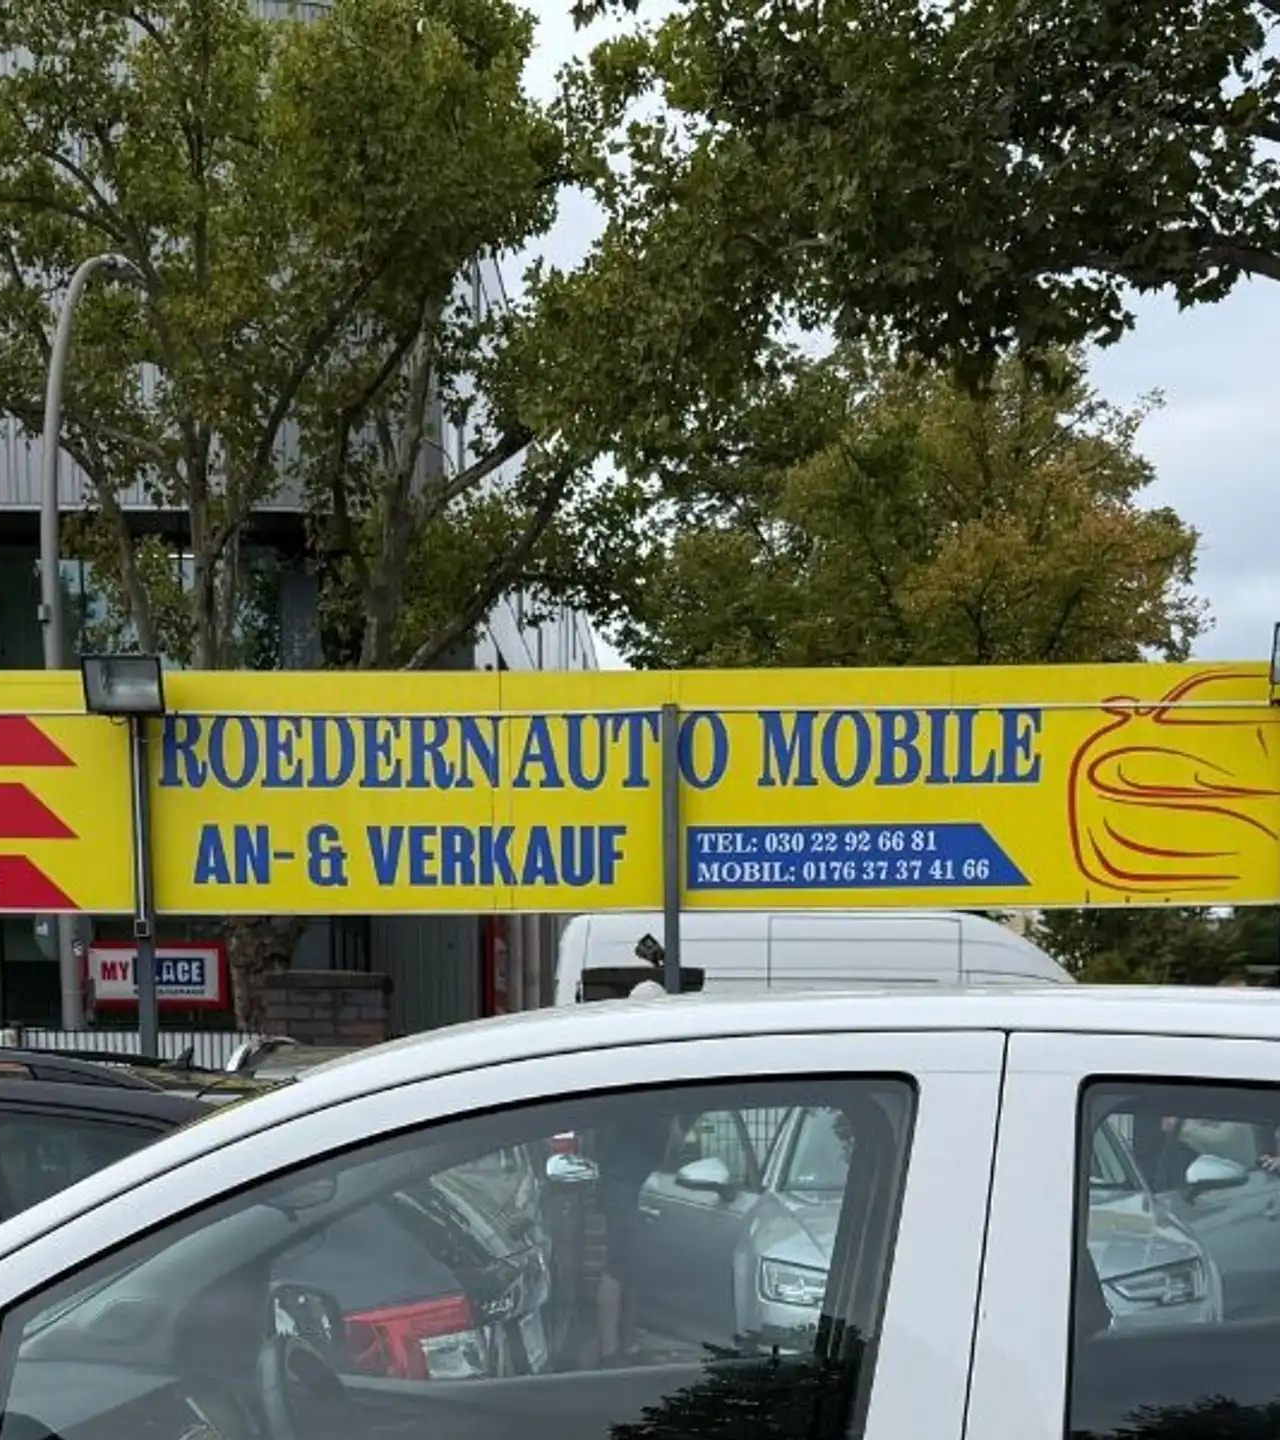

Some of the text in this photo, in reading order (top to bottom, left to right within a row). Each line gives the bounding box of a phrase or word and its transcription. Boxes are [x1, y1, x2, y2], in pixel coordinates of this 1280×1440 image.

[757, 708, 1042, 788] MOBILE
[697, 830, 937, 853] TEL: 030 22 92 66 81
[193, 824, 627, 886] AN- & VERKAUF
[697, 858, 990, 883] MOBIL: 0176 37 37 41 66
[101, 960, 203, 983] MY ACE
